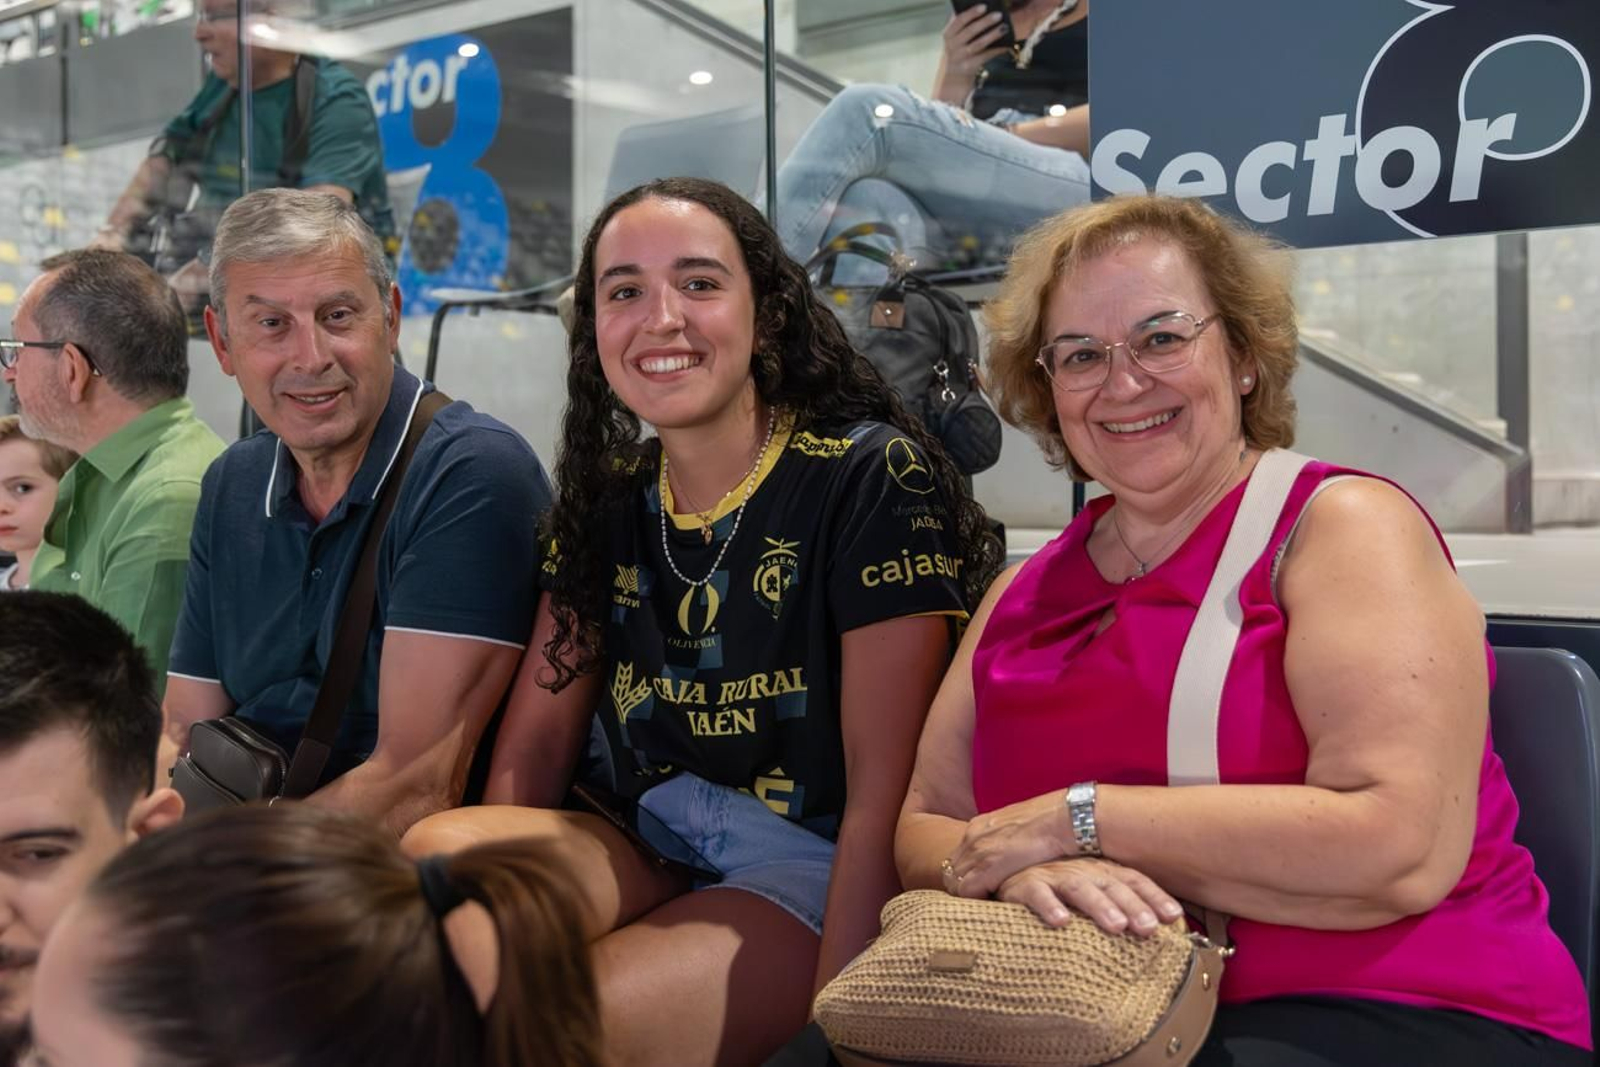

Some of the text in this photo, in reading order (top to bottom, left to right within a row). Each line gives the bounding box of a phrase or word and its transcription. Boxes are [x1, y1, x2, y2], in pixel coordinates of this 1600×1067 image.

[366, 54, 468, 117] ctor
[1091, 113, 1517, 223] Sector
[861, 549, 964, 588] cajasur
[652, 667, 808, 705] CAJA RURAL
